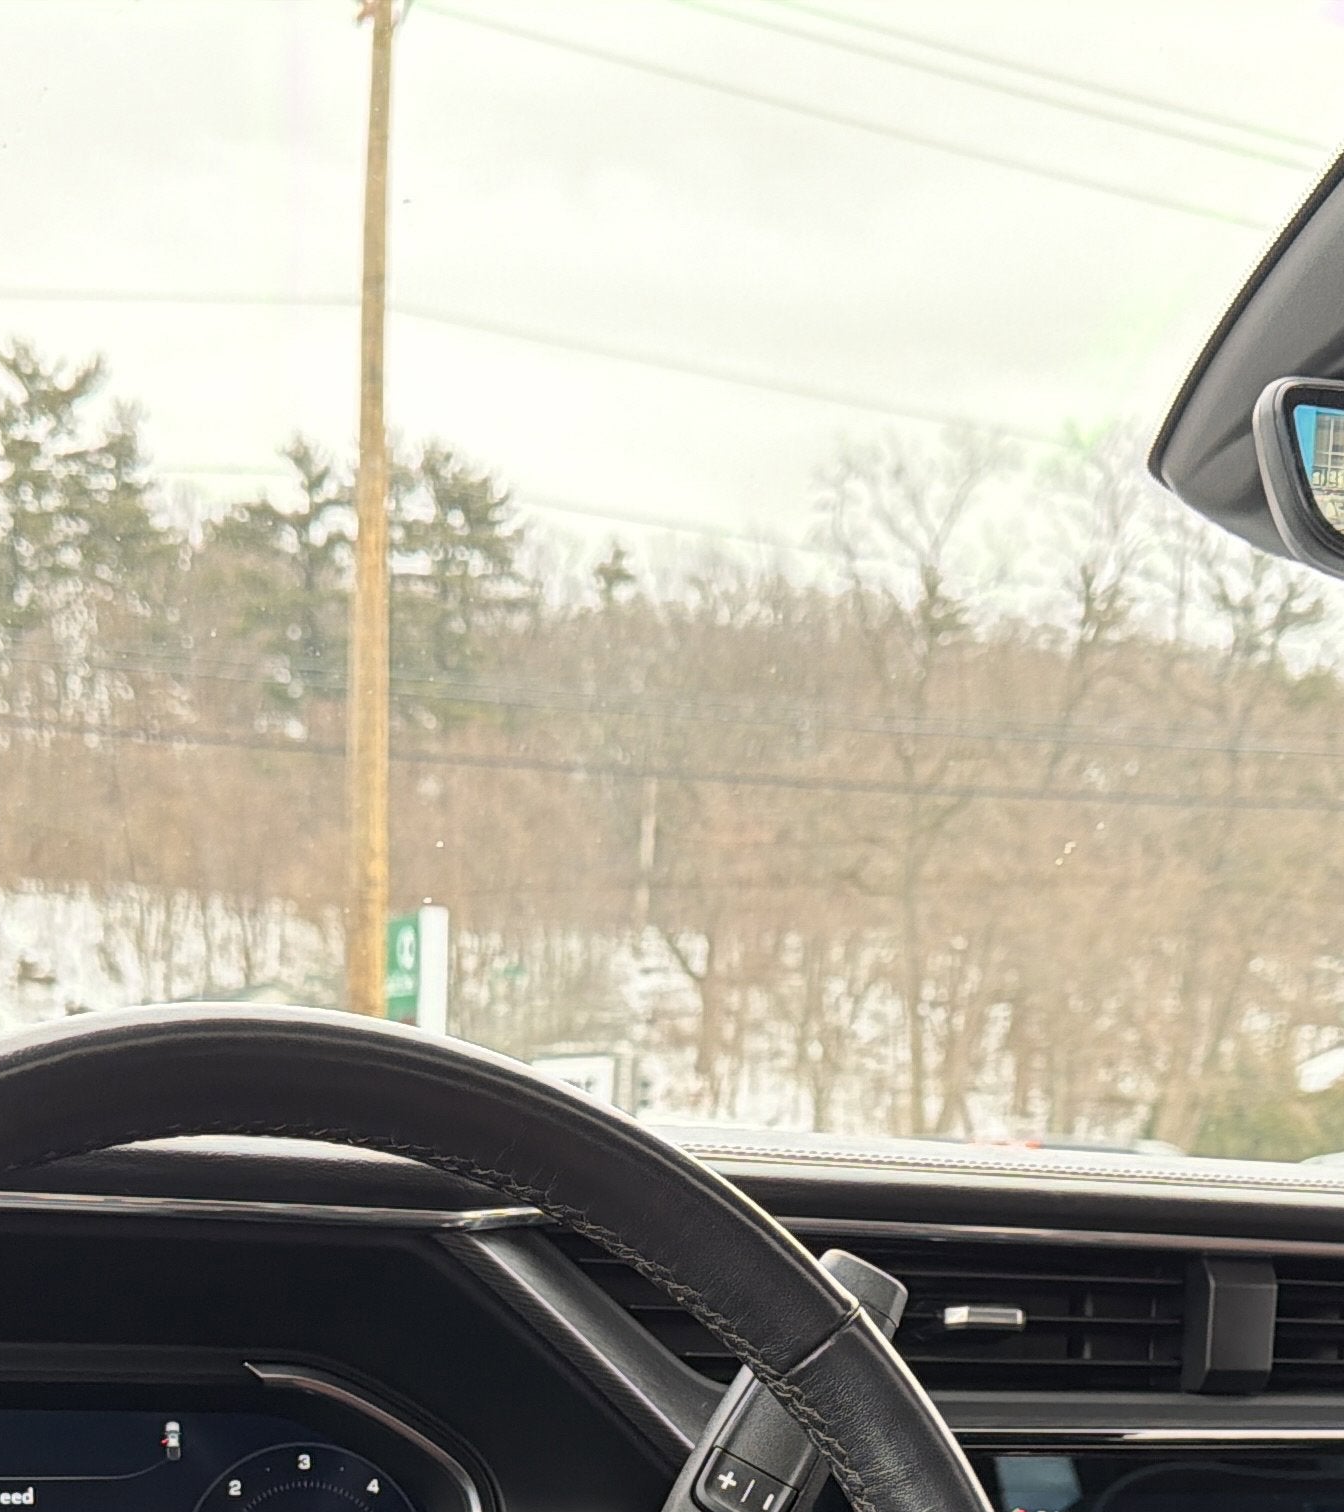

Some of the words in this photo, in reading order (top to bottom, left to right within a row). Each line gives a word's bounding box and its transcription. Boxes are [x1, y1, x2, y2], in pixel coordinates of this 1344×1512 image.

[297, 1454, 311, 1470] 3
[228, 1479, 242, 1496] 2
[366, 1478, 380, 1494] 4
